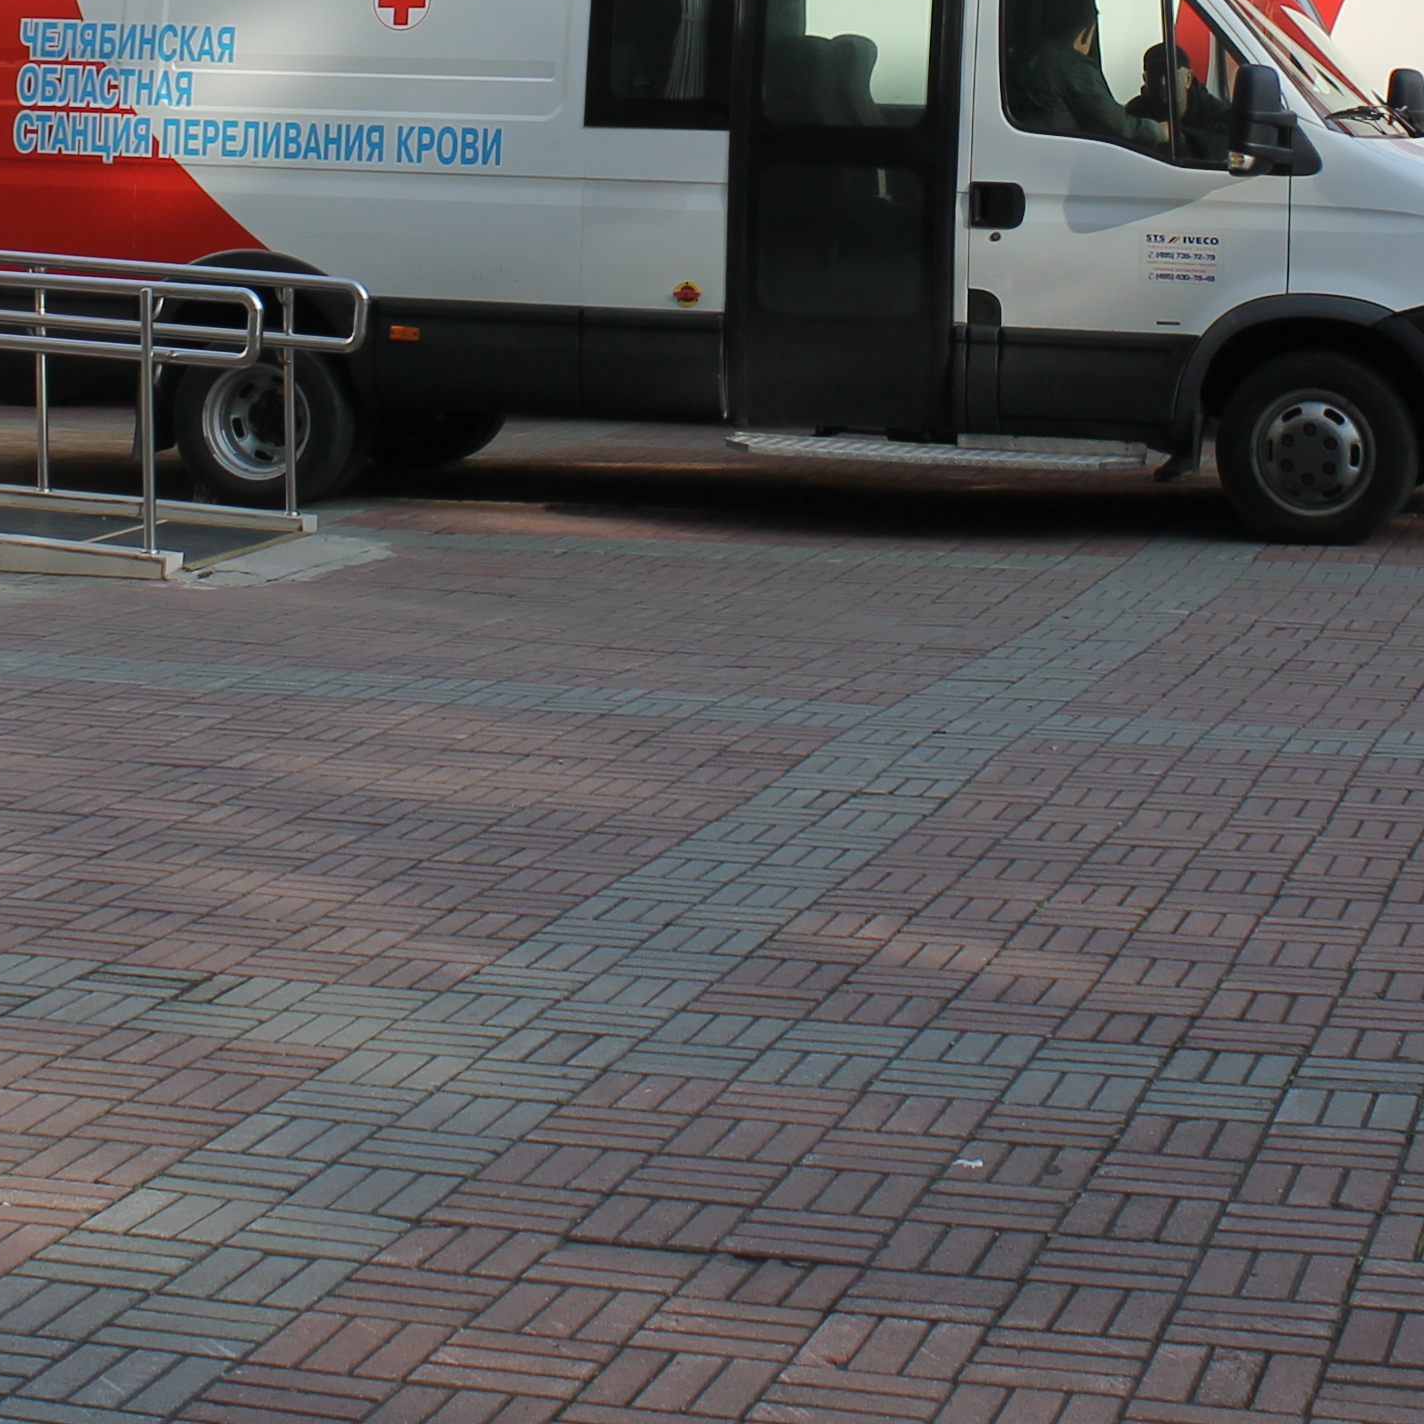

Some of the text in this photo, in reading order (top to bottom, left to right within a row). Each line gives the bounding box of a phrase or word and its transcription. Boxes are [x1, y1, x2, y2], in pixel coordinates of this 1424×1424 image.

[19, 18, 236, 63] ЧЕЛЯБИНСКАЯ
[16, 63, 194, 108] ОБЛАСТНАЯ
[13, 109, 503, 167] СТАНЦИЯ ПЕРЕЛИВАНИЯ КРОВИ
[1146, 234, 1219, 245] STS IVECO
